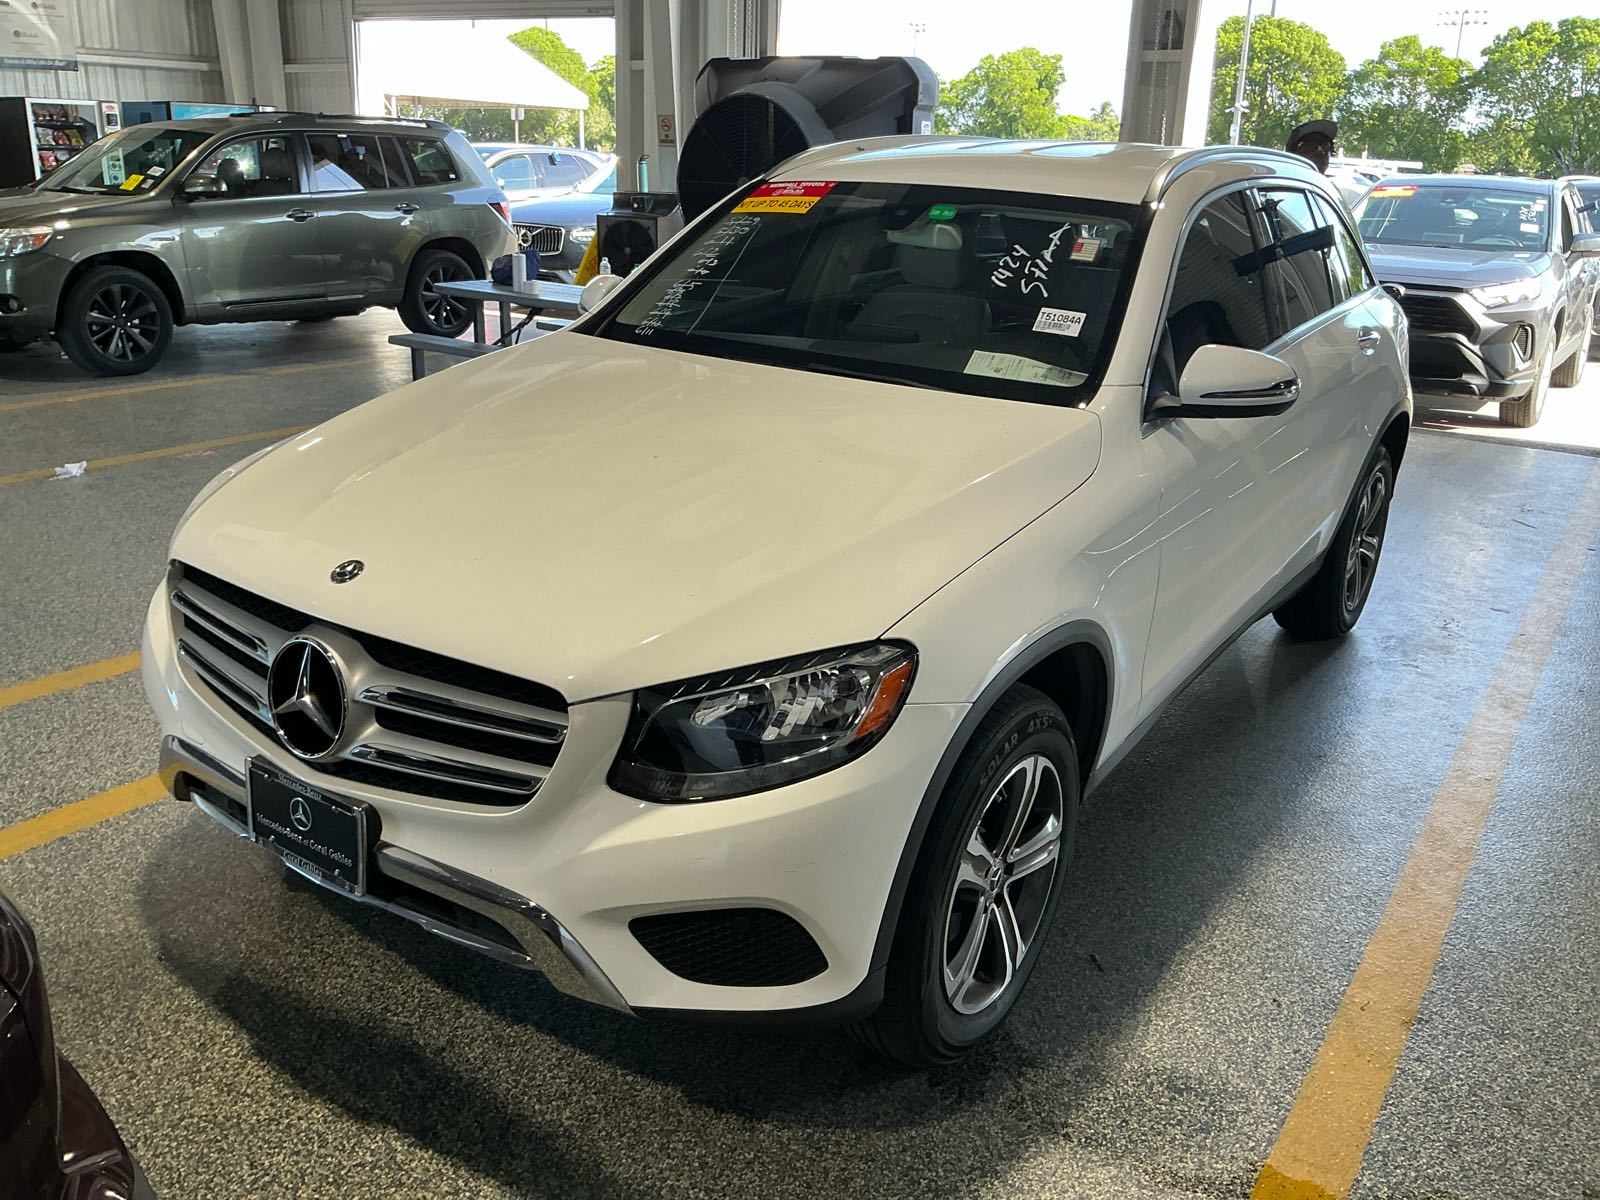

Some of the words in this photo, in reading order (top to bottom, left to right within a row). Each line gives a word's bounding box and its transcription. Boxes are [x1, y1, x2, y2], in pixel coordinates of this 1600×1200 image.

[752, 200, 766, 209] UP
[766, 200, 778, 209] TO
[778, 200, 790, 209] 45
[789, 200, 814, 209] DAYS
[1041, 312, 1081, 325] T51084A
[256, 812, 302, 843] Mercedes-Benz
[309, 839, 328, 856] Coral
[329, 848, 352, 867] Gables
